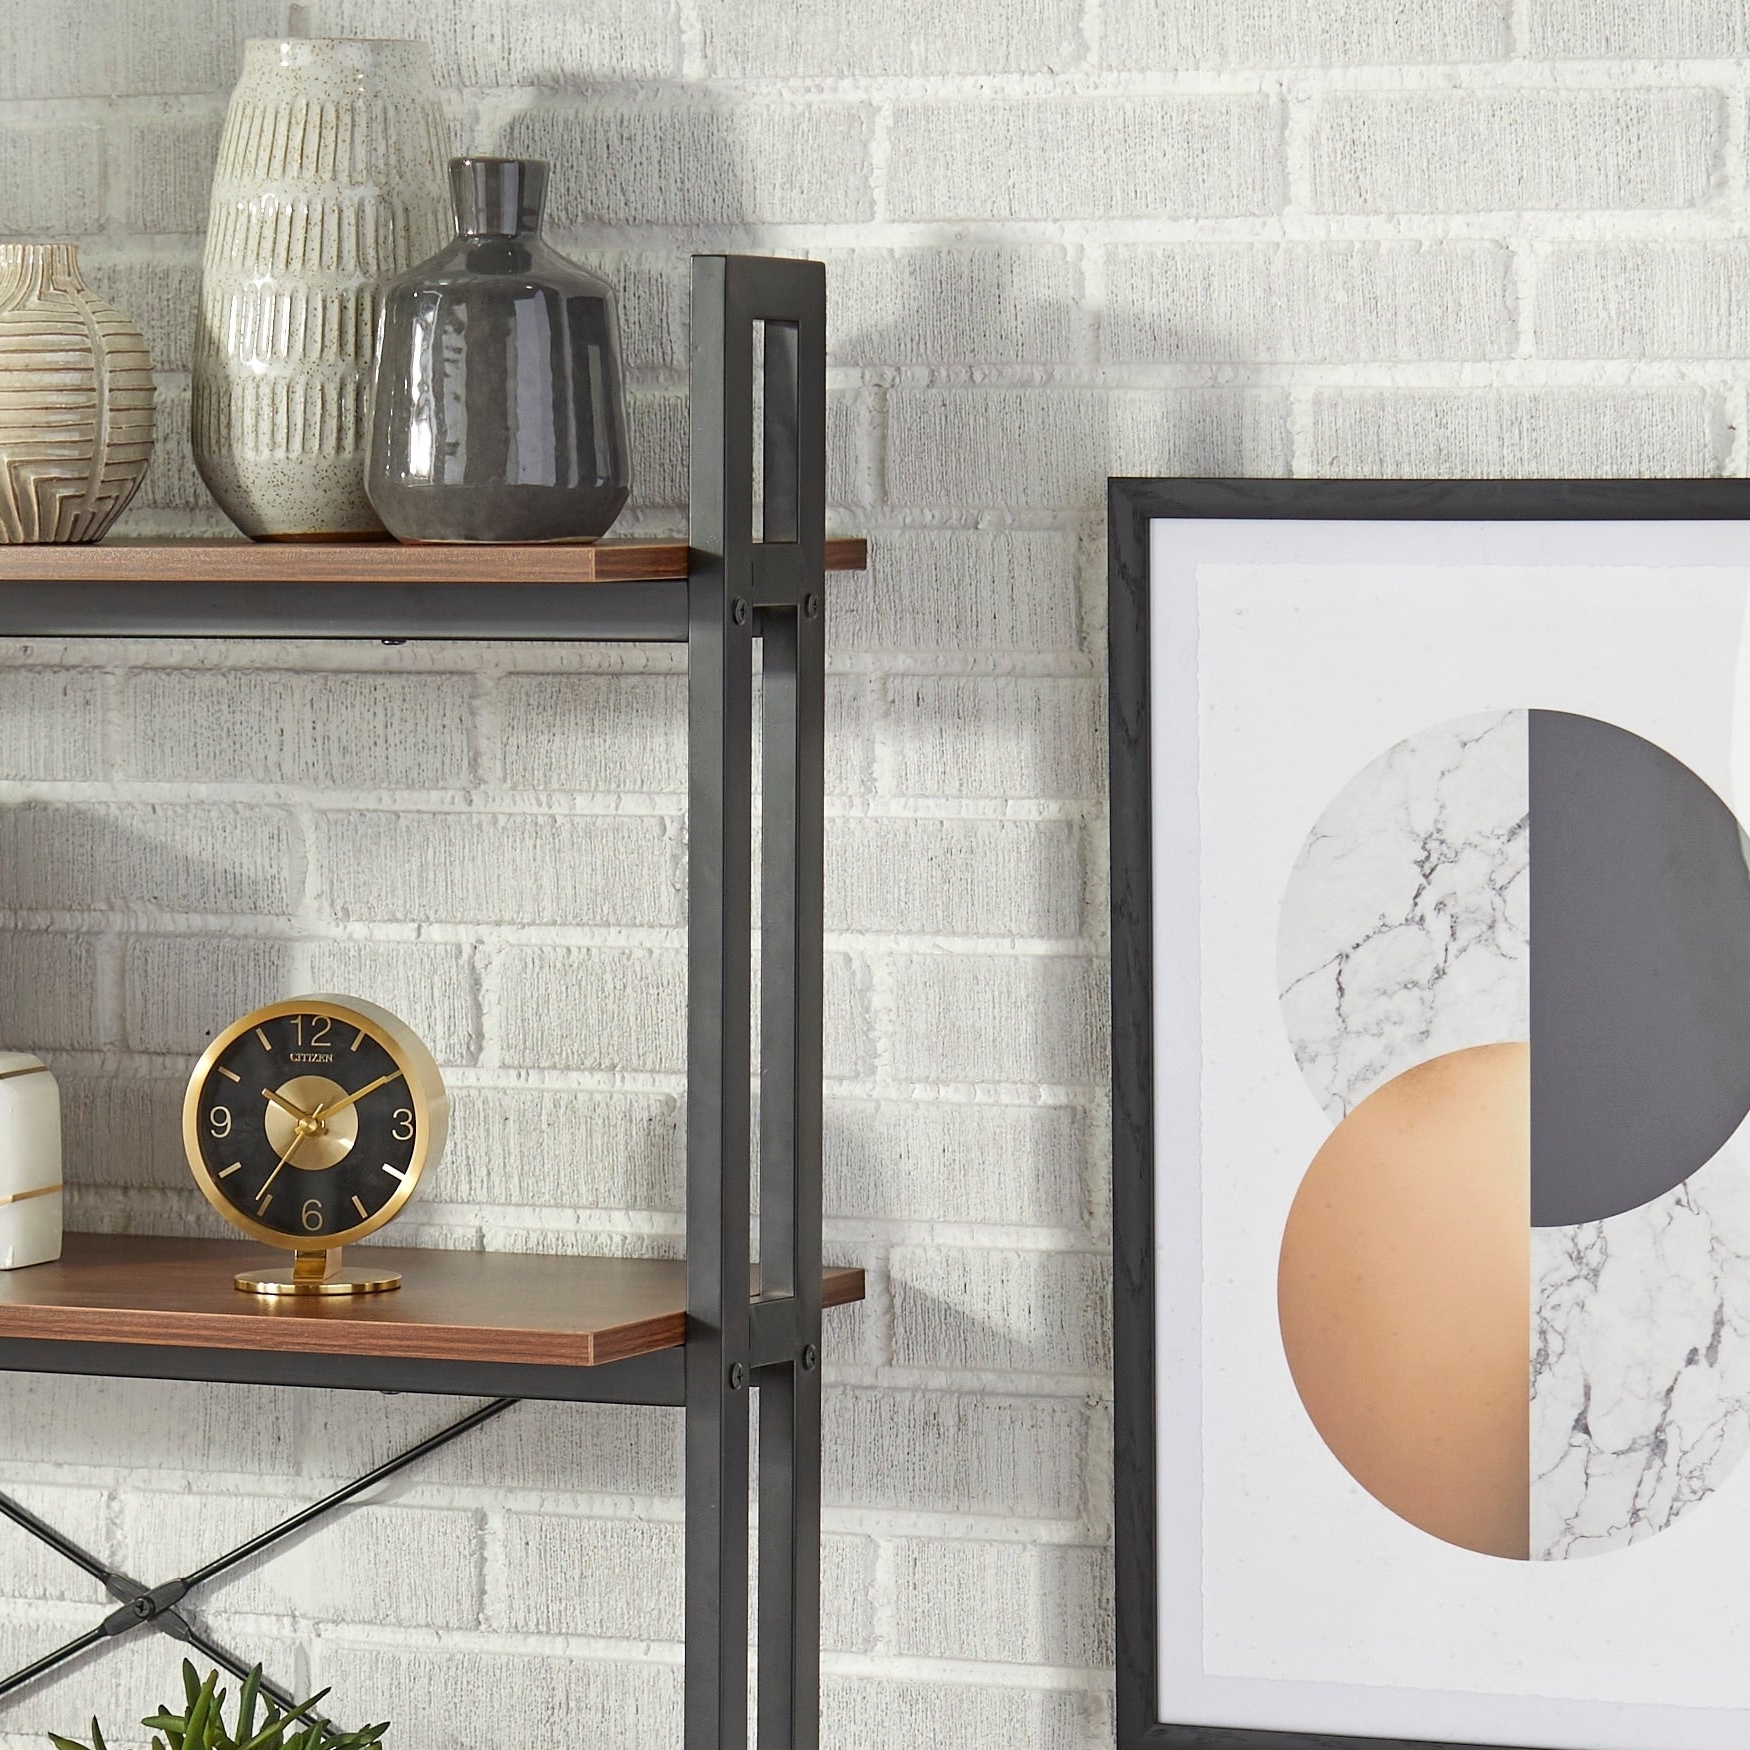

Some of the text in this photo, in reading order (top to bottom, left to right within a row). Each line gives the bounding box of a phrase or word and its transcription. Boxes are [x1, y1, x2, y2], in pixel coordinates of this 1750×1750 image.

[290, 1014, 332, 1047] 12
[290, 1053, 333, 1063] CITIZEN
[210, 1106, 232, 1139] 9
[391, 1109, 414, 1141] 3
[301, 1199, 323, 1231] 6
